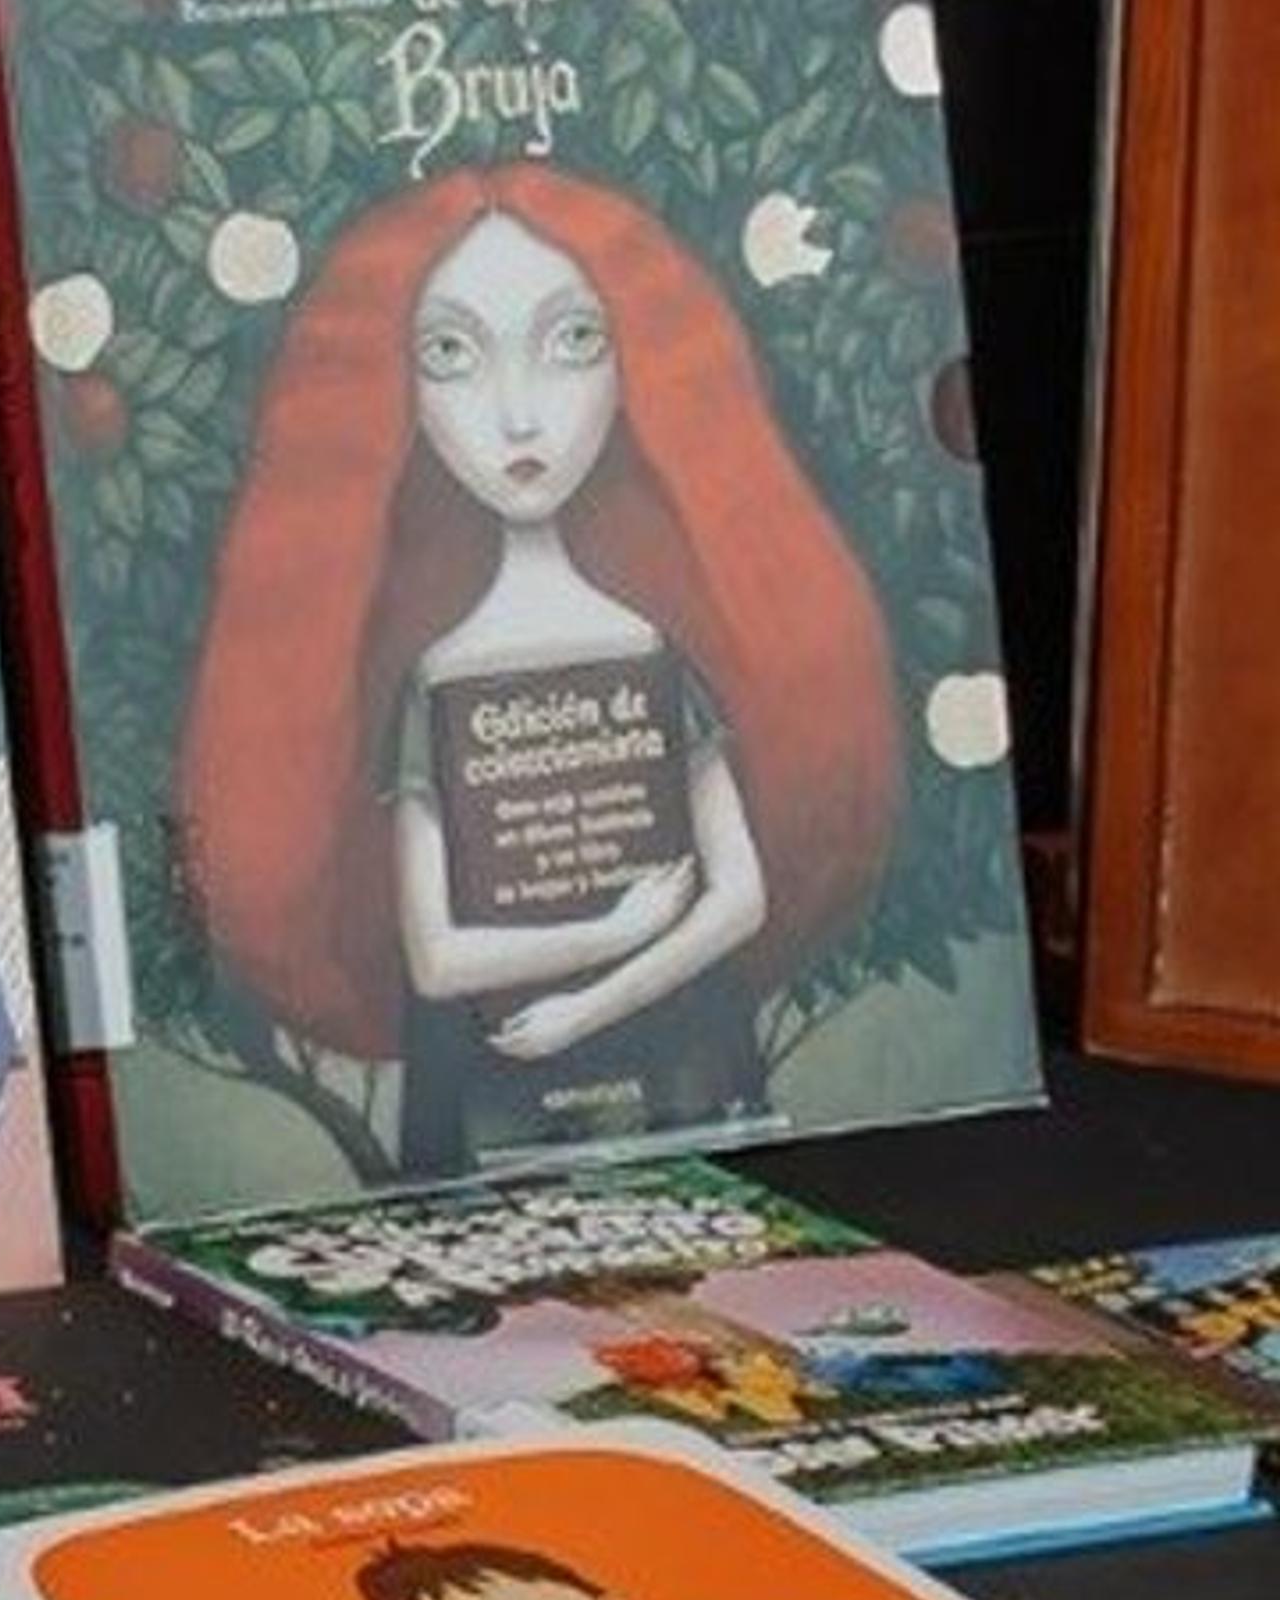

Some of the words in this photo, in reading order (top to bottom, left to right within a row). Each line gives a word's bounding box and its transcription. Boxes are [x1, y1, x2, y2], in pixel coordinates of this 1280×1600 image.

[376, 21, 581, 179] Bruja
[609, 684, 648, 721] de
[228, 1514, 324, 1545] La
